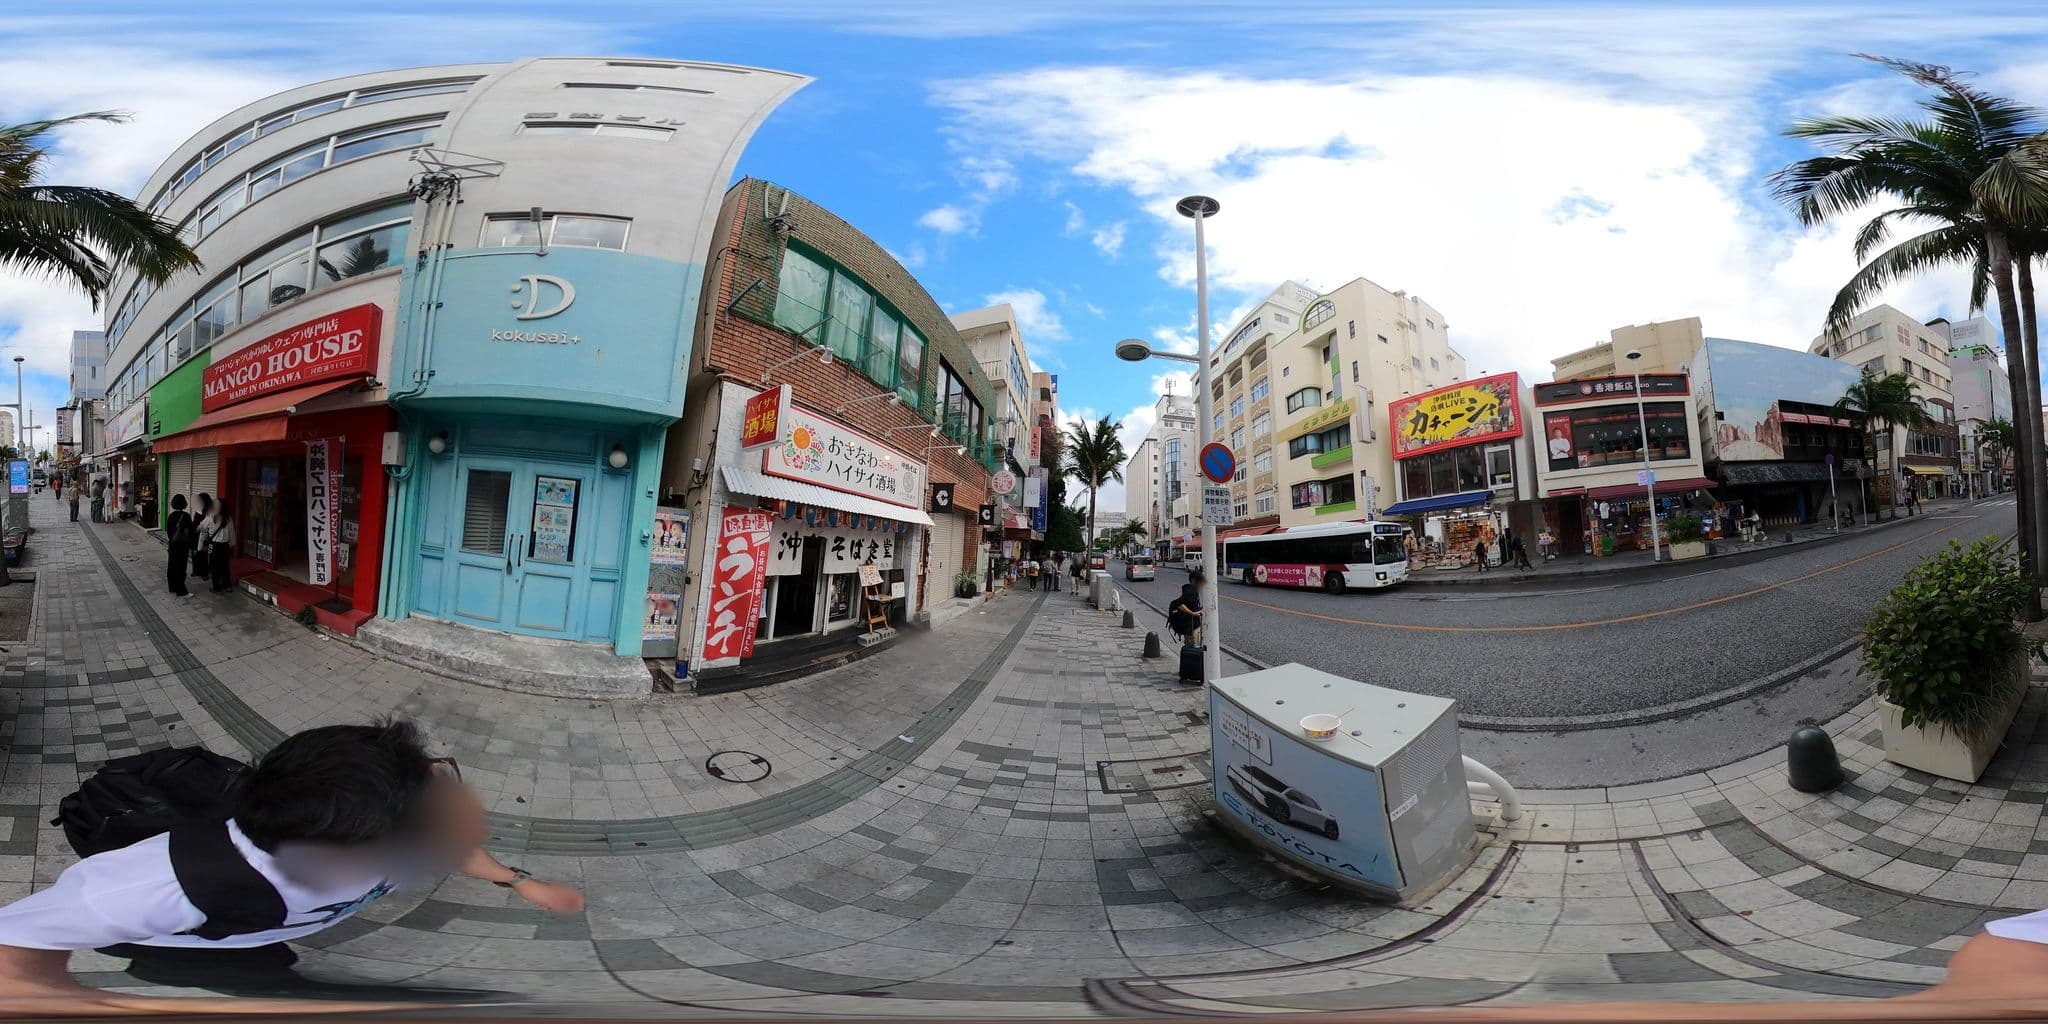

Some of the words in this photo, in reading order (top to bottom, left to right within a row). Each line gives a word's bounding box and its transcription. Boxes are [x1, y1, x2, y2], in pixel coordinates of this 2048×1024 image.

[204, 361, 262, 400] MANGO
[267, 329, 363, 376] HOUSE
[229, 387, 248, 400] MADE
[250, 385, 257, 394] IN
[258, 371, 302, 393] OKINAWA
[1595, 381, 1633, 393] 香港飯店
[748, 394, 780, 413] ハイサイ
[744, 410, 777, 439] 酒場
[828, 436, 878, 469] おきなわ
[826, 459, 897, 495] ハイサイ酒場
[726, 514, 766, 533] 味自慢
[778, 531, 893, 562] 沖そば食堂
[706, 536, 755, 655] ランチ
[1246, 809, 1364, 875] TOYOTA
